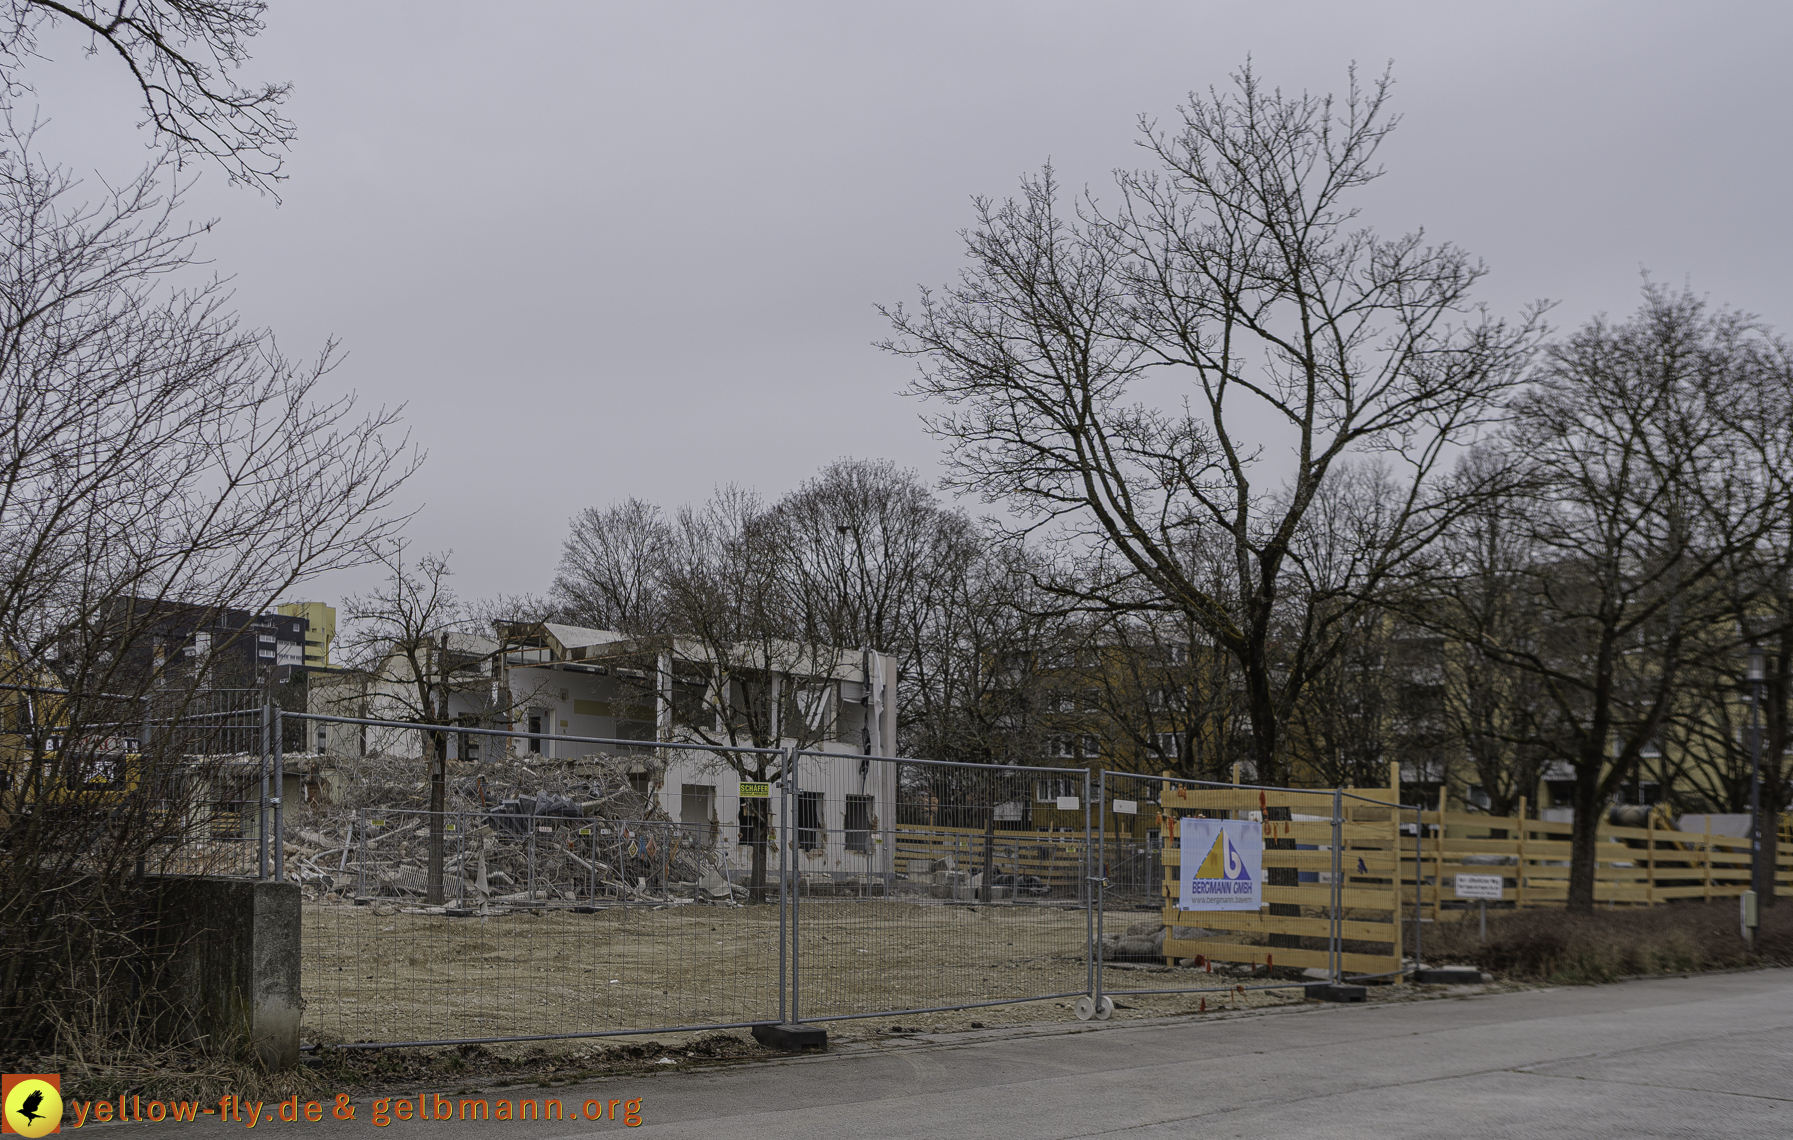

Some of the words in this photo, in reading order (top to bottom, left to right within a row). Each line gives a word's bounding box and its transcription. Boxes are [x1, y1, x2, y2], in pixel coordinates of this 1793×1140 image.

[1192, 881, 1232, 894] BERGMANN
[1233, 882, 1253, 894] GMBH
[1191, 896, 1253, 905] www.bergmann.bayern
